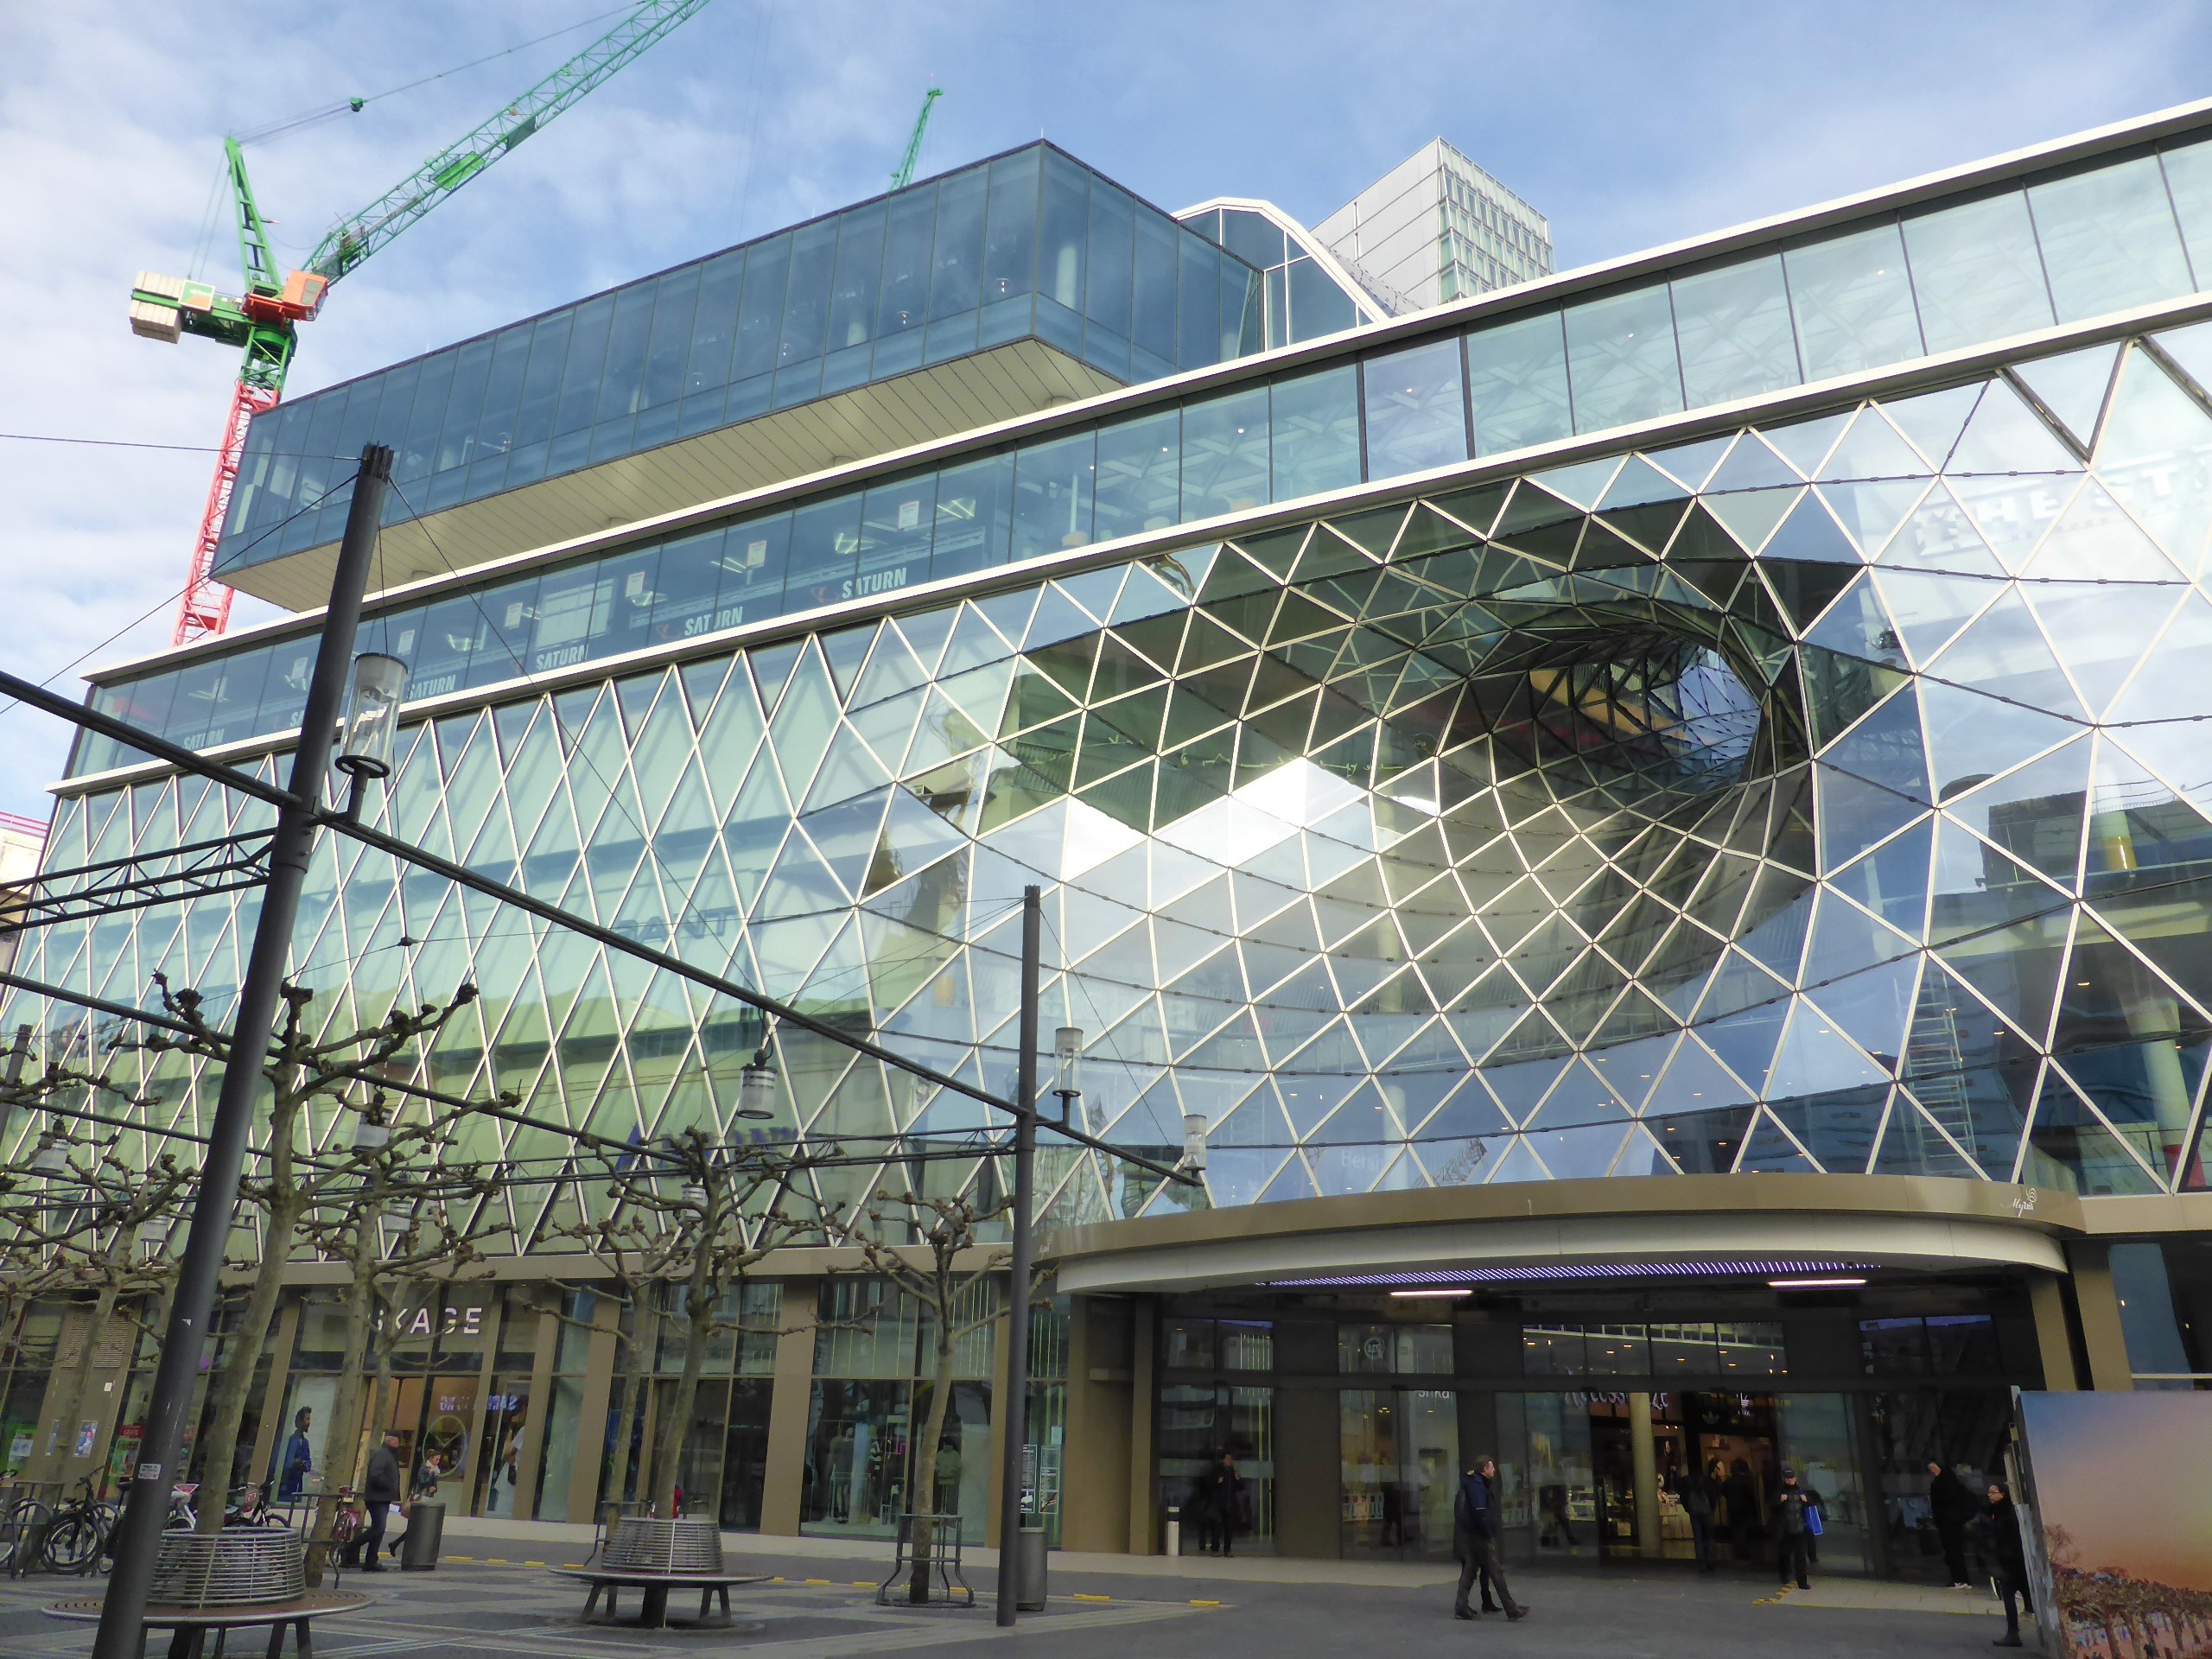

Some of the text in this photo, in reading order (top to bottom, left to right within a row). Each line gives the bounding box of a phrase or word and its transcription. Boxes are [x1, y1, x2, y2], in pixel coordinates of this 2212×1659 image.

[842, 568, 907, 599] SATURN
[684, 607, 743, 636] SATURN
[536, 644, 589, 671] SATURN
[407, 675, 456, 700] SATURN
